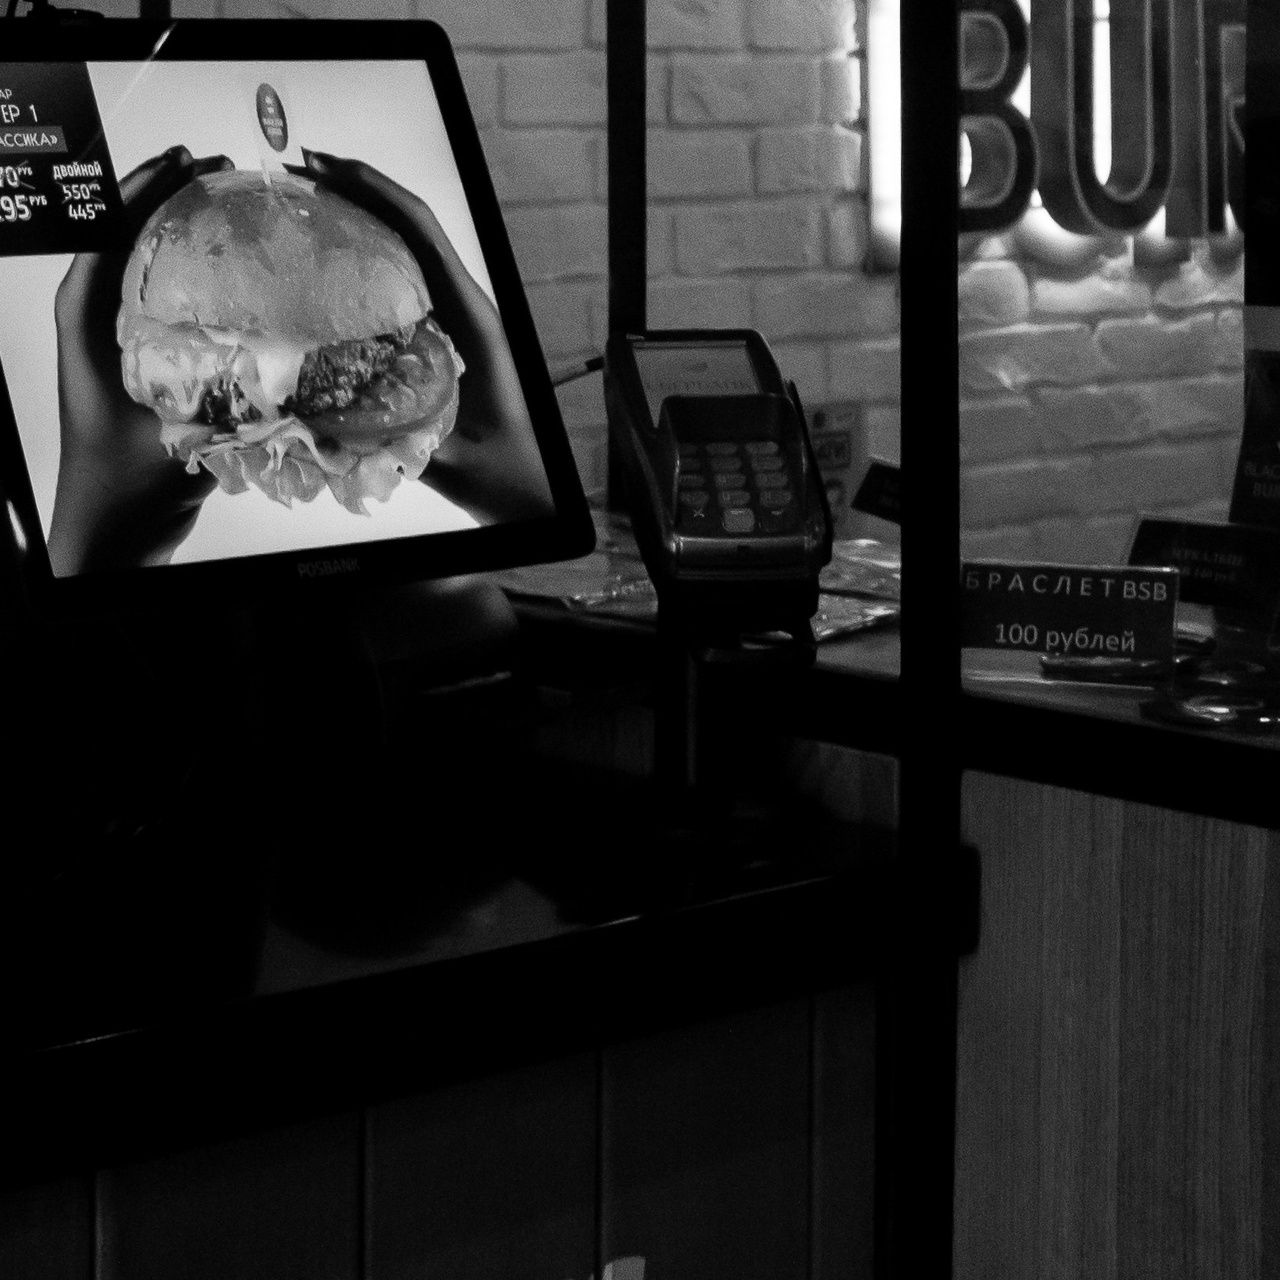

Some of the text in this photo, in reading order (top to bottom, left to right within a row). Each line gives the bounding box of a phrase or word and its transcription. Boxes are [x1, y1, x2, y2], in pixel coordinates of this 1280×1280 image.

[29, 104, 38, 123] 1
[53, 161, 103, 180] ДВОЙНОЙ
[69, 204, 95, 219] 445
[1123, 580, 1168, 602] BSB
[995, 623, 1136, 653] 100 рублей
